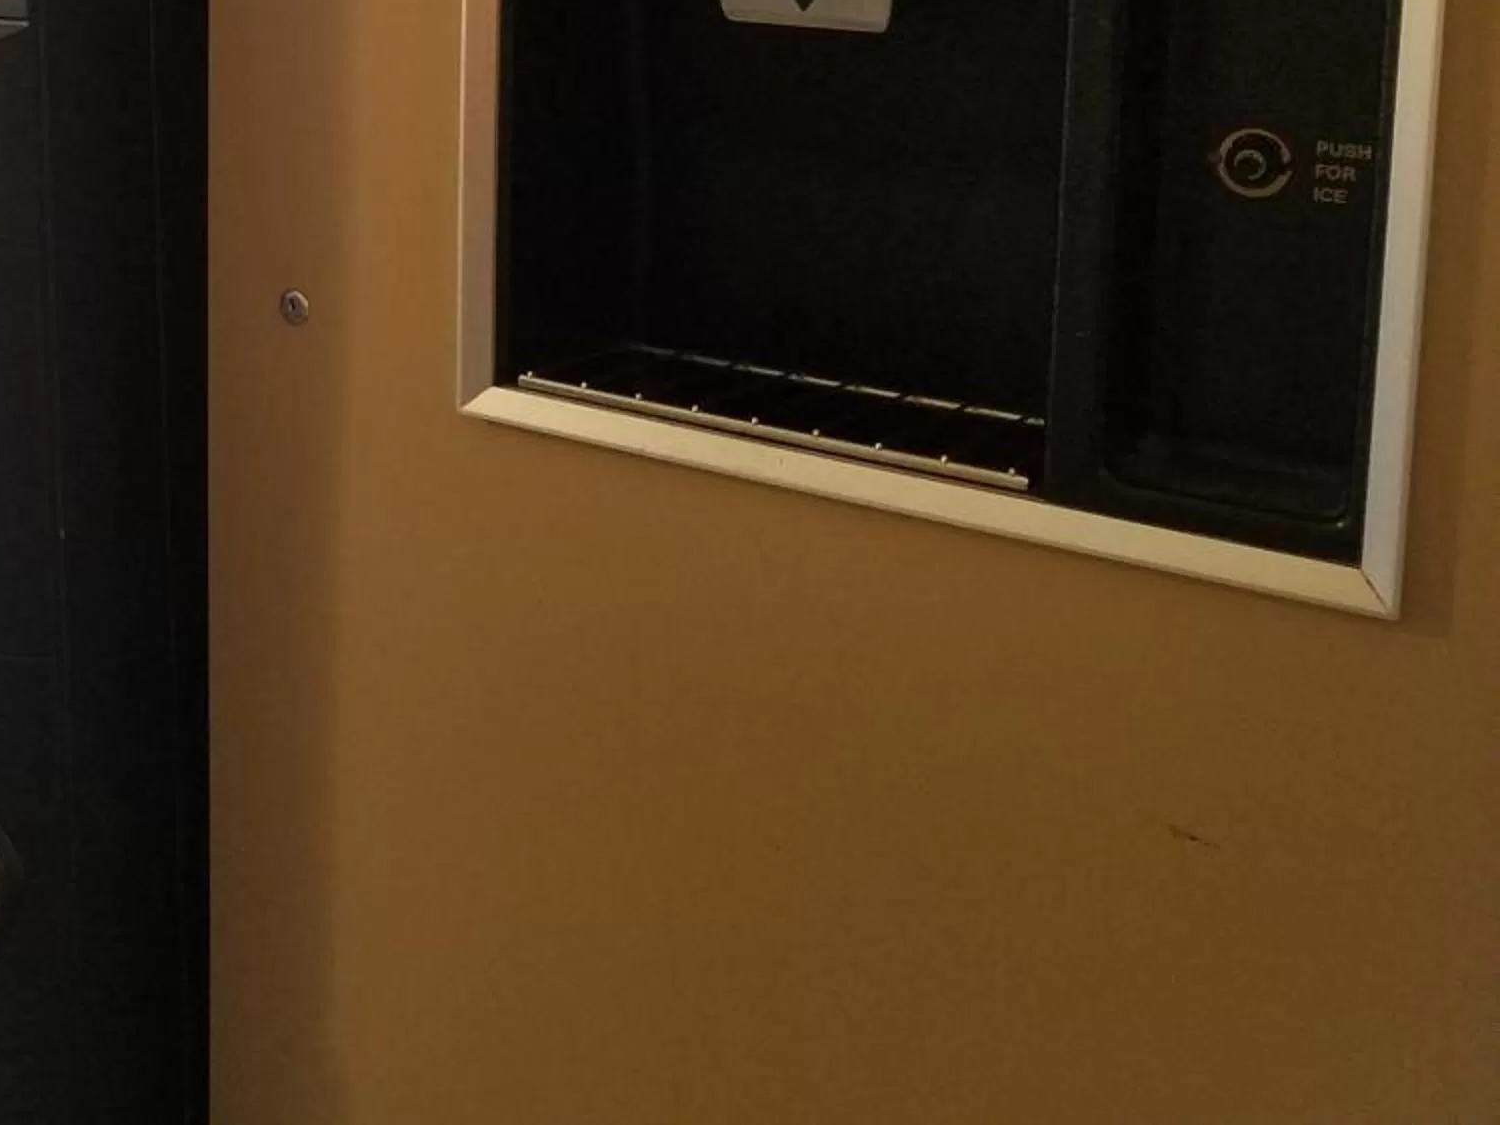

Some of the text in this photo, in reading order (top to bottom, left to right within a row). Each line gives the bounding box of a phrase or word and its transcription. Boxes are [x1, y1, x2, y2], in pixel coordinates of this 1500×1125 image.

[1316, 140, 1373, 160] PUSH
[1315, 164, 1357, 183] FOR
[1313, 186, 1349, 204] ICE
